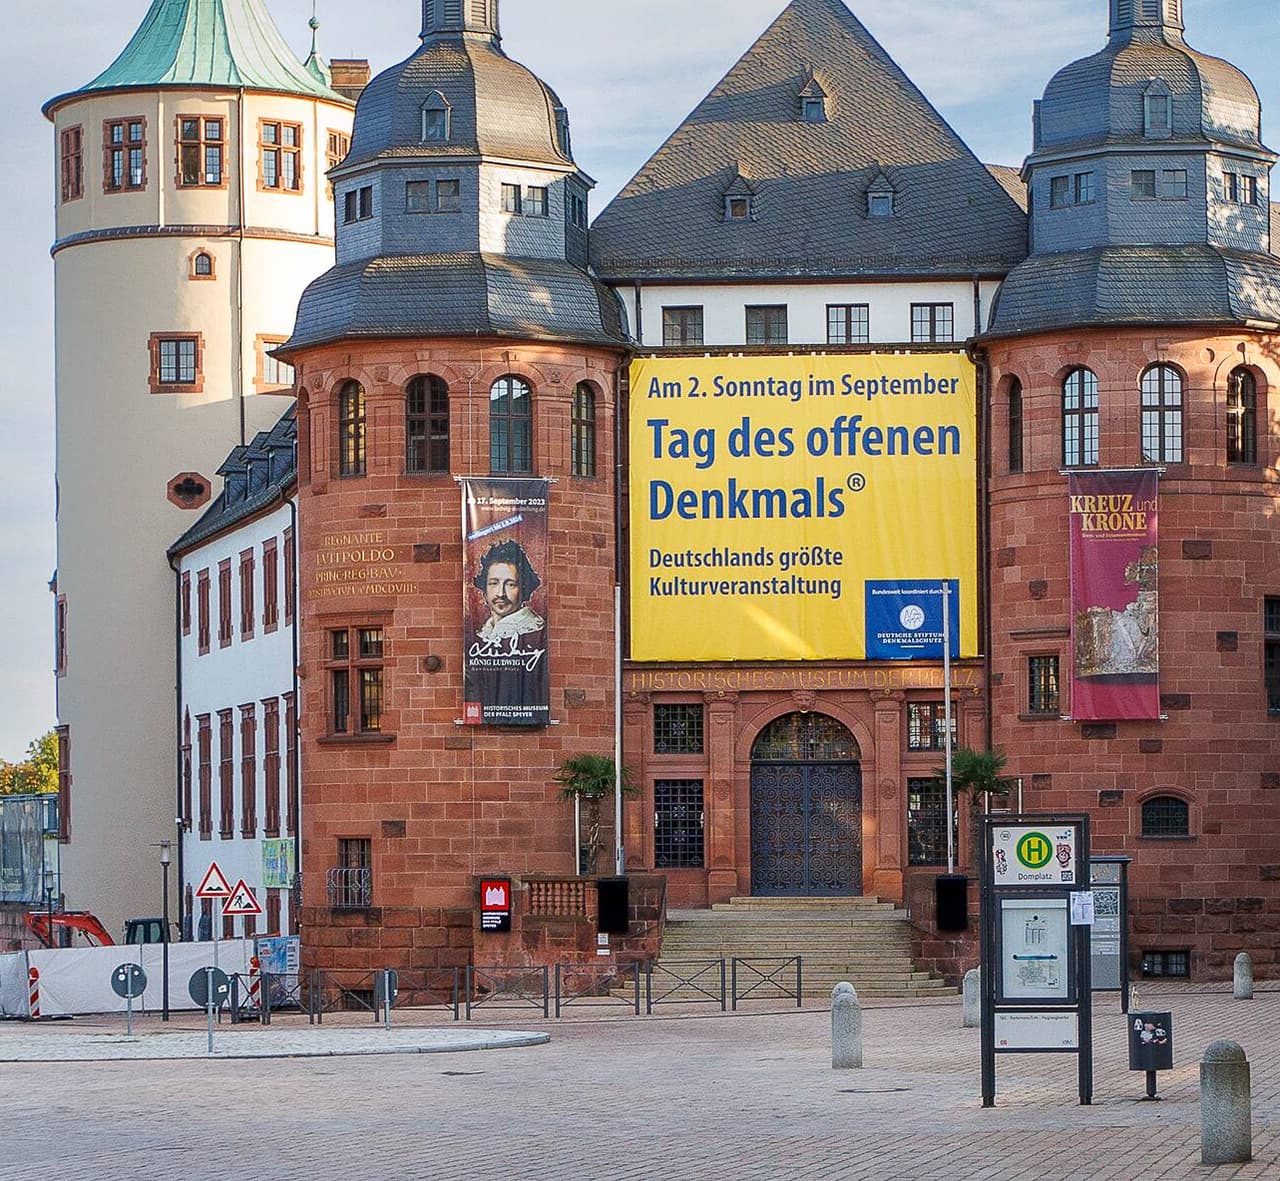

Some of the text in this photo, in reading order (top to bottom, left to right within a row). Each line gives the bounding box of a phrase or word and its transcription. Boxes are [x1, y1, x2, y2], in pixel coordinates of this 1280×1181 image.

[648, 373, 959, 402] Am 2. Sonntag im September
[647, 415, 961, 469] Tag des offenen
[489, 497, 527, 506] September
[1070, 494, 1157, 513] KREUZ und
[1081, 512, 1147, 531] KRONE
[324, 532, 383, 546] REGNANTE
[649, 546, 843, 571] Deutschlands größte
[649, 576, 842, 598] Kulturveranstaltung
[469, 658, 492, 666] KÖNIG
[631, 671, 775, 690] HISTORISCHES
[782, 670, 868, 689] MUSEUM
[874, 670, 914, 687] DER
[1026, 839, 1043, 861] H
[1017, 872, 1053, 881] Domplatz
